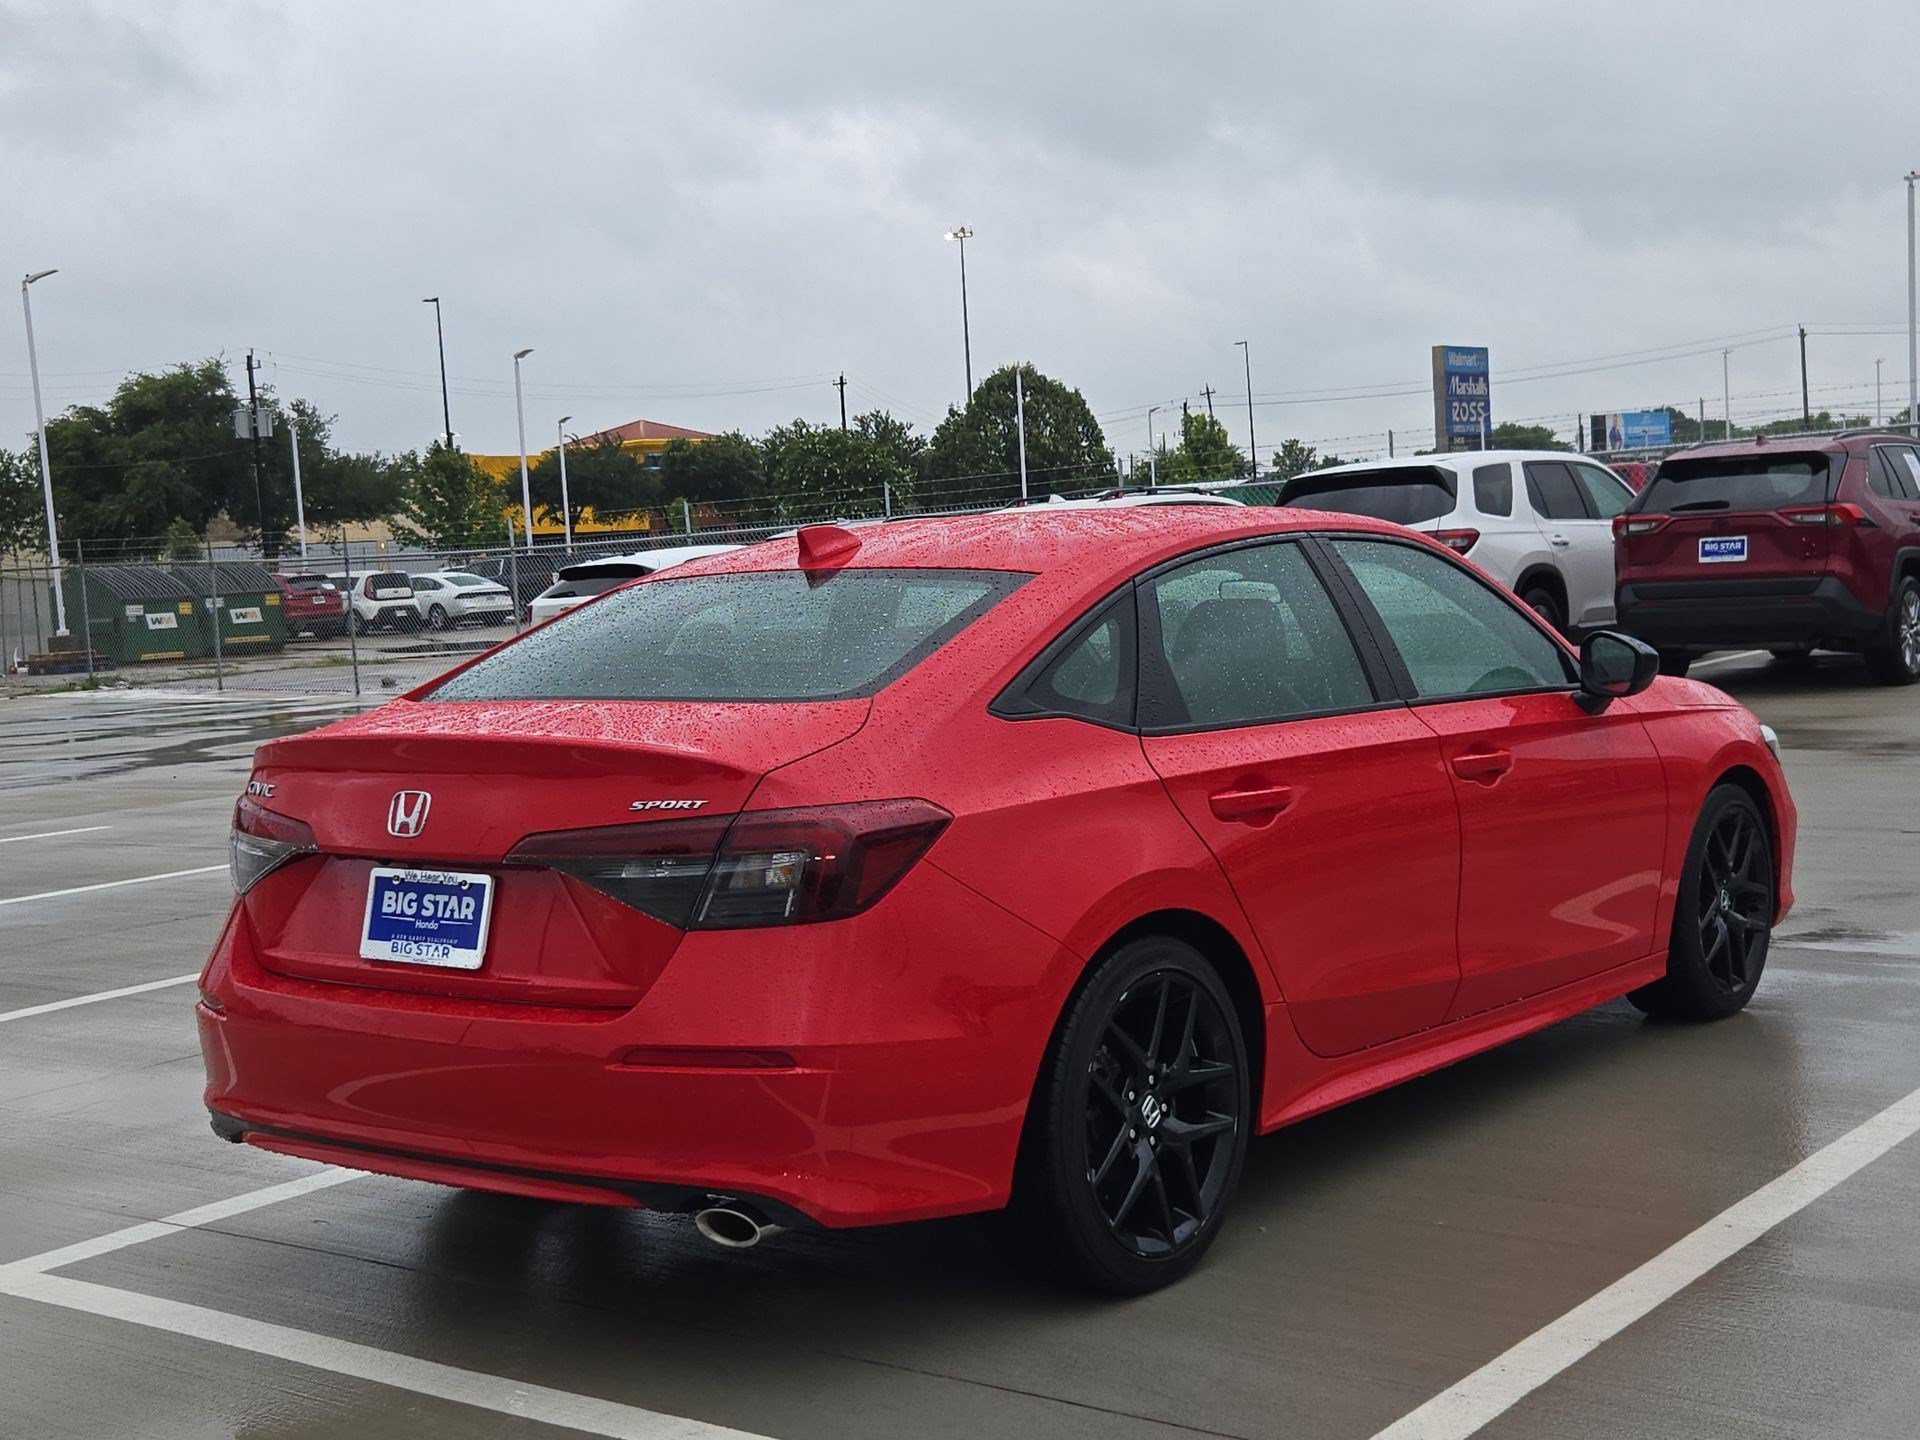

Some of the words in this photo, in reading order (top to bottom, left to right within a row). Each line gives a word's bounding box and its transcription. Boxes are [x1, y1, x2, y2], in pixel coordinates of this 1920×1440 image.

[1448, 376, 1488, 395] Marshalls
[1452, 401, 1485, 422] ROSS
[1704, 543, 1719, 551] BIG
[1720, 542, 1742, 550] STAR
[628, 800, 709, 810] SPORT
[404, 871, 418, 881] We
[420, 872, 440, 883] Hear
[442, 873, 458, 885] You
[382, 890, 418, 915] BIG
[421, 893, 475, 920] STAR
[415, 920, 439, 930] Honda
[391, 941, 413, 955] BIG
[415, 943, 450, 958] STAR
